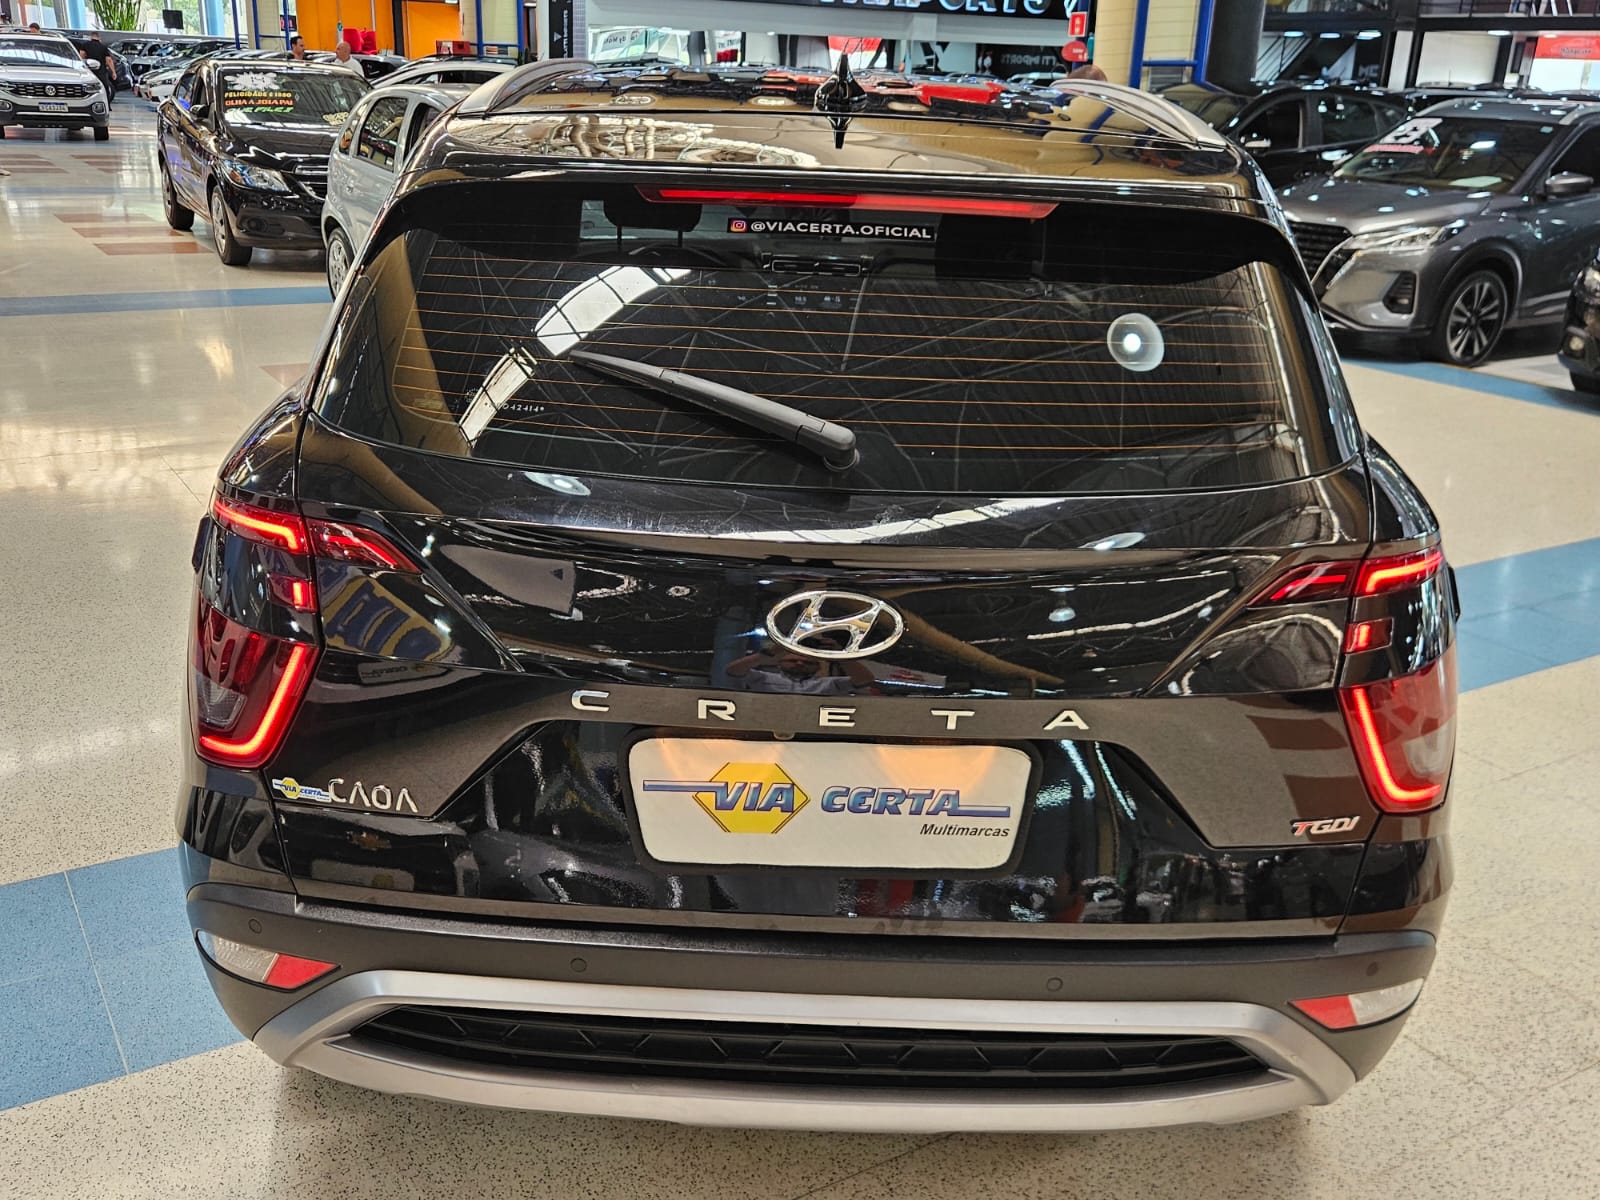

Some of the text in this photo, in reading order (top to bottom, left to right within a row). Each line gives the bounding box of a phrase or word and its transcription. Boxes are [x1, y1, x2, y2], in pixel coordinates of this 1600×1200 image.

[750, 220, 932, 239] @VIACERTA.OFICIAL
[570, 689, 1090, 731] CRETA
[284, 784, 322, 797] VIA CERTA
[713, 780, 961, 818] VIA CERTA
[919, 822, 1011, 838] Multimarcas
[1292, 815, 1361, 837] TGDI
